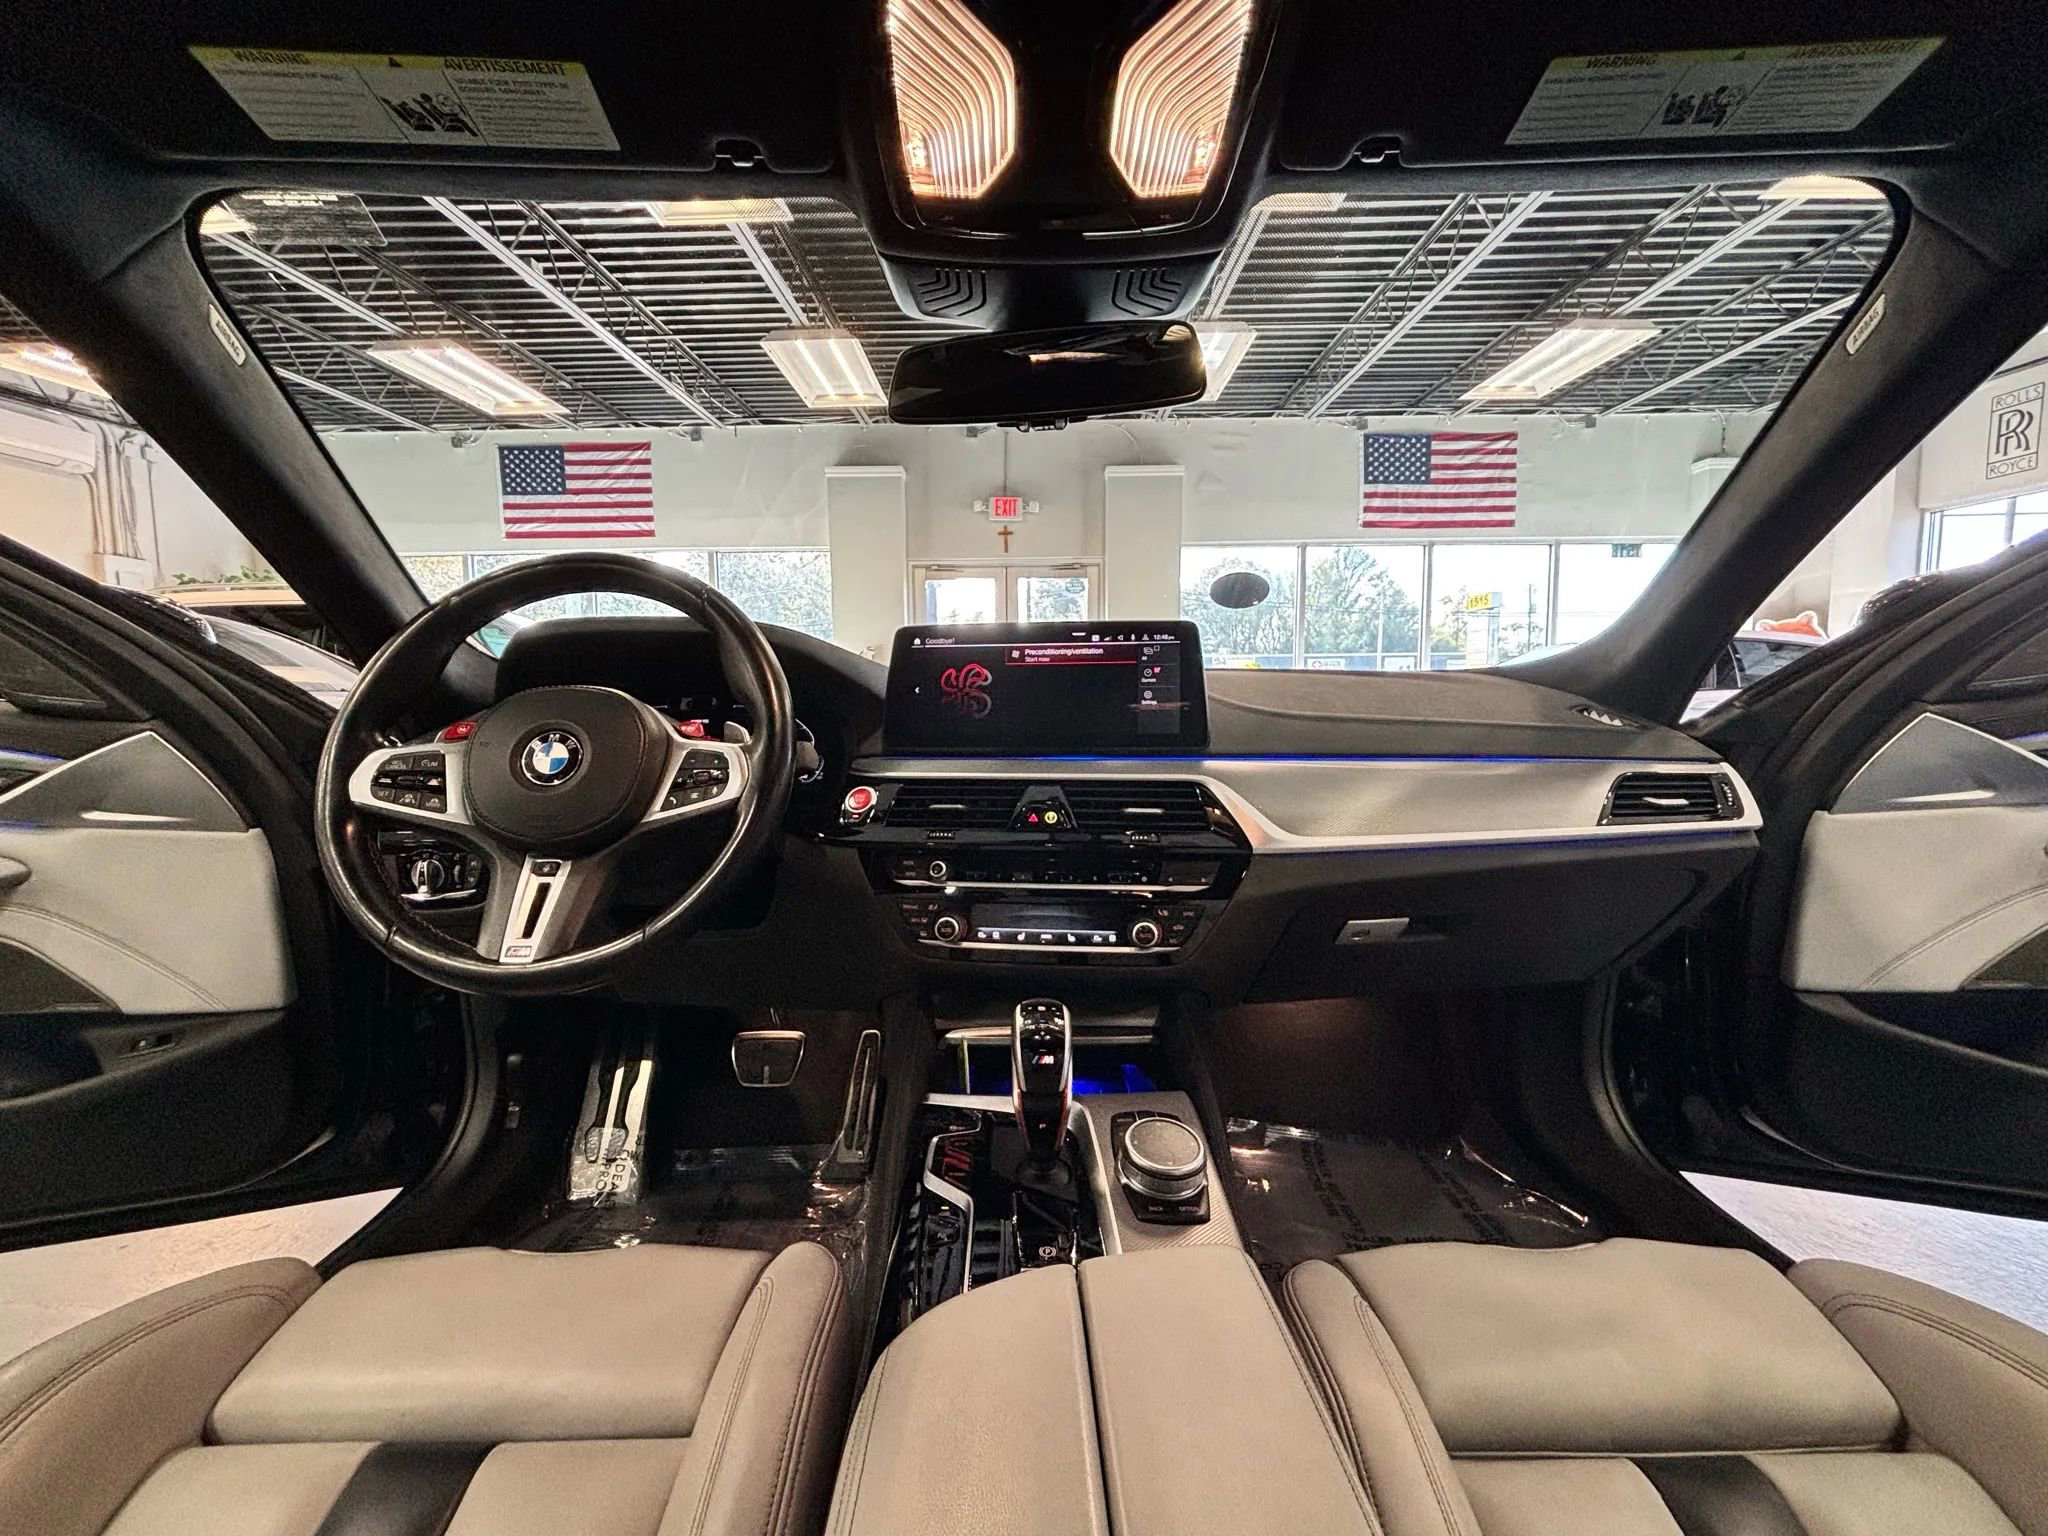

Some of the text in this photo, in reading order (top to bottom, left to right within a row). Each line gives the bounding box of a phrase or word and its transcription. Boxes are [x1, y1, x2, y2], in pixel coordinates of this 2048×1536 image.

[231, 48, 310, 65] WARNING
[1585, 53, 1659, 69] WARNING
[443, 57, 567, 76] AVERTISSEMENT
[1995, 385, 2042, 408] ROLLS
[1989, 457, 2034, 475] ROYCE
[995, 498, 1018, 517] EXIT
[925, 637, 955, 645] Goodbye!
[531, 732, 578, 751] BMW
